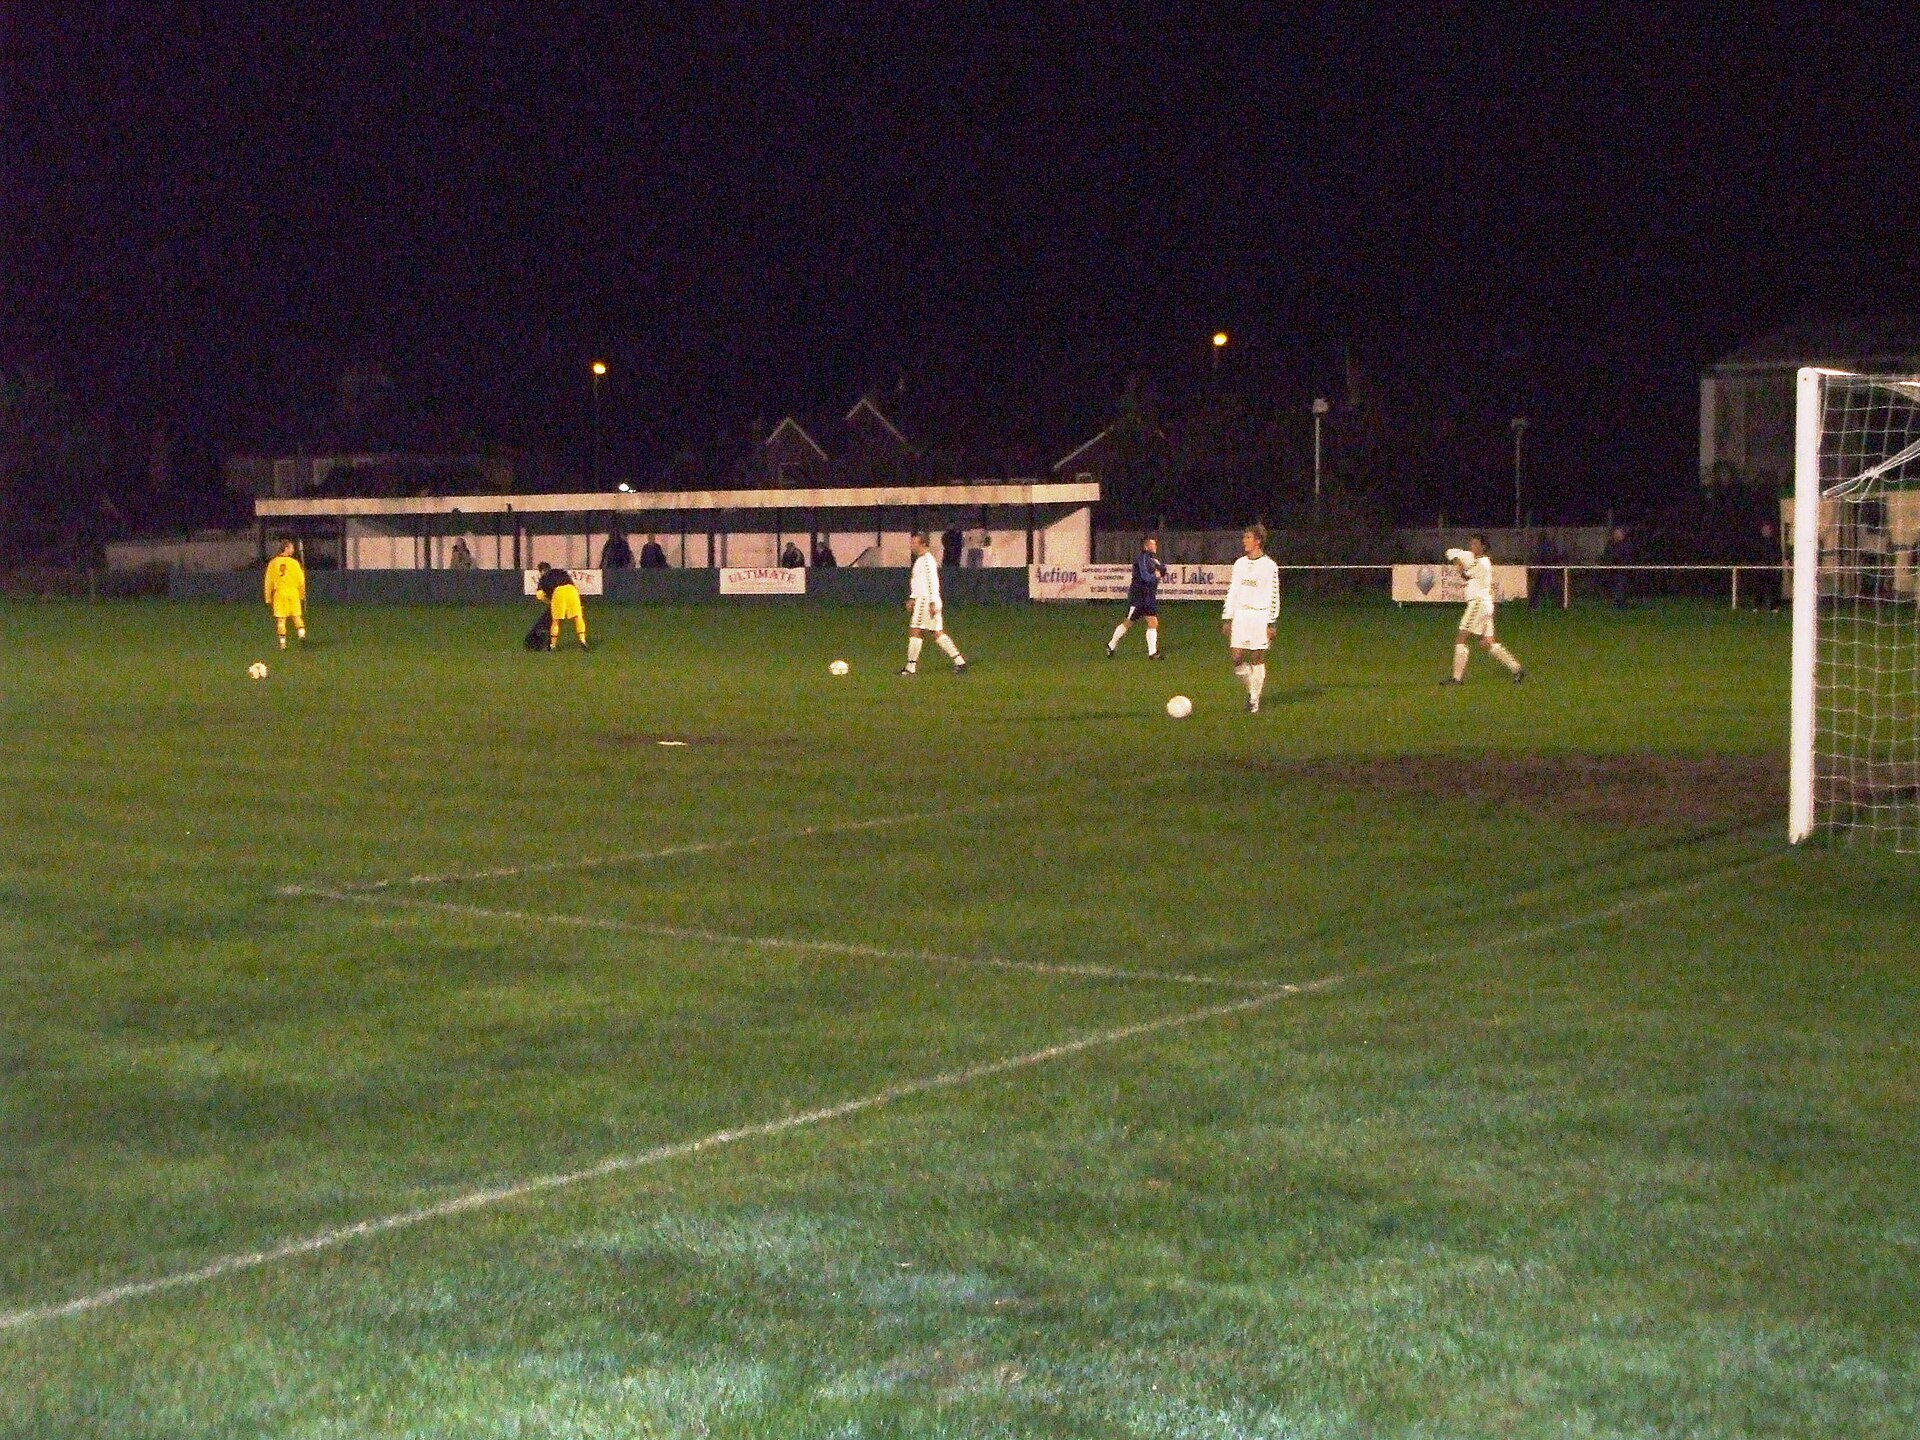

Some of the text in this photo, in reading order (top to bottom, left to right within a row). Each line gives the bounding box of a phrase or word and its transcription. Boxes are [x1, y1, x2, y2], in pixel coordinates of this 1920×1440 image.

[728, 569, 797, 584] ULTIMATE
[1035, 566, 1078, 584] Action
[1181, 566, 1214, 585] Lake
